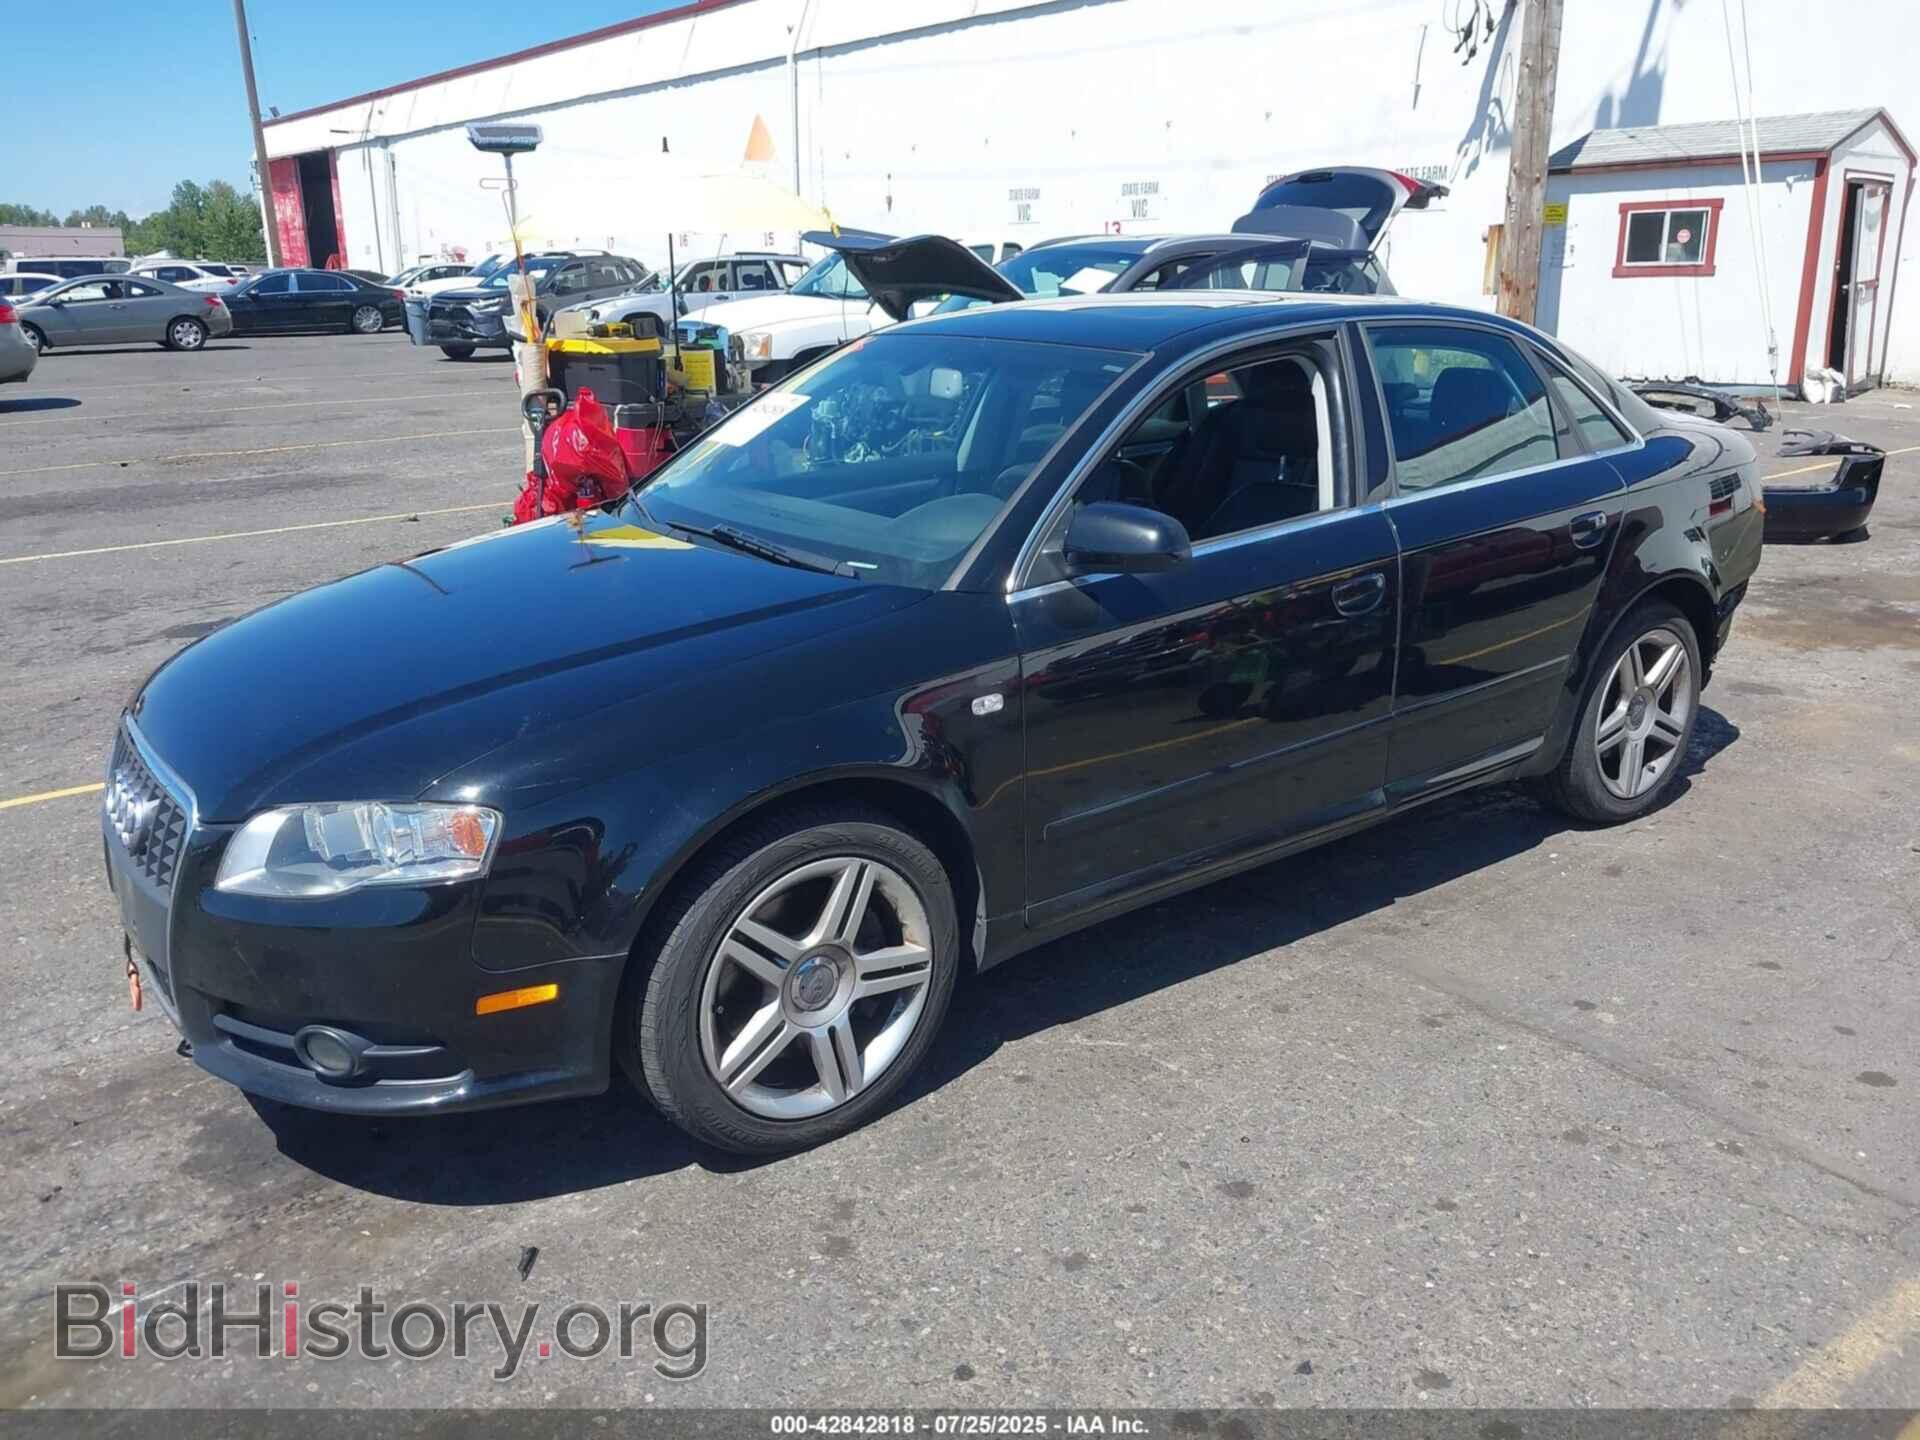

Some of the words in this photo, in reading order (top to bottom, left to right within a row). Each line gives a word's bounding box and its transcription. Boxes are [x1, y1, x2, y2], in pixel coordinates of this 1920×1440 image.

[1421, 165, 1448, 181] FARM
[1121, 182, 1139, 196] STATE
[1140, 180, 1160, 195] FARM
[1017, 203, 1031, 221] VIC
[1131, 198, 1148, 218] VIC
[763, 231, 775, 247] 15
